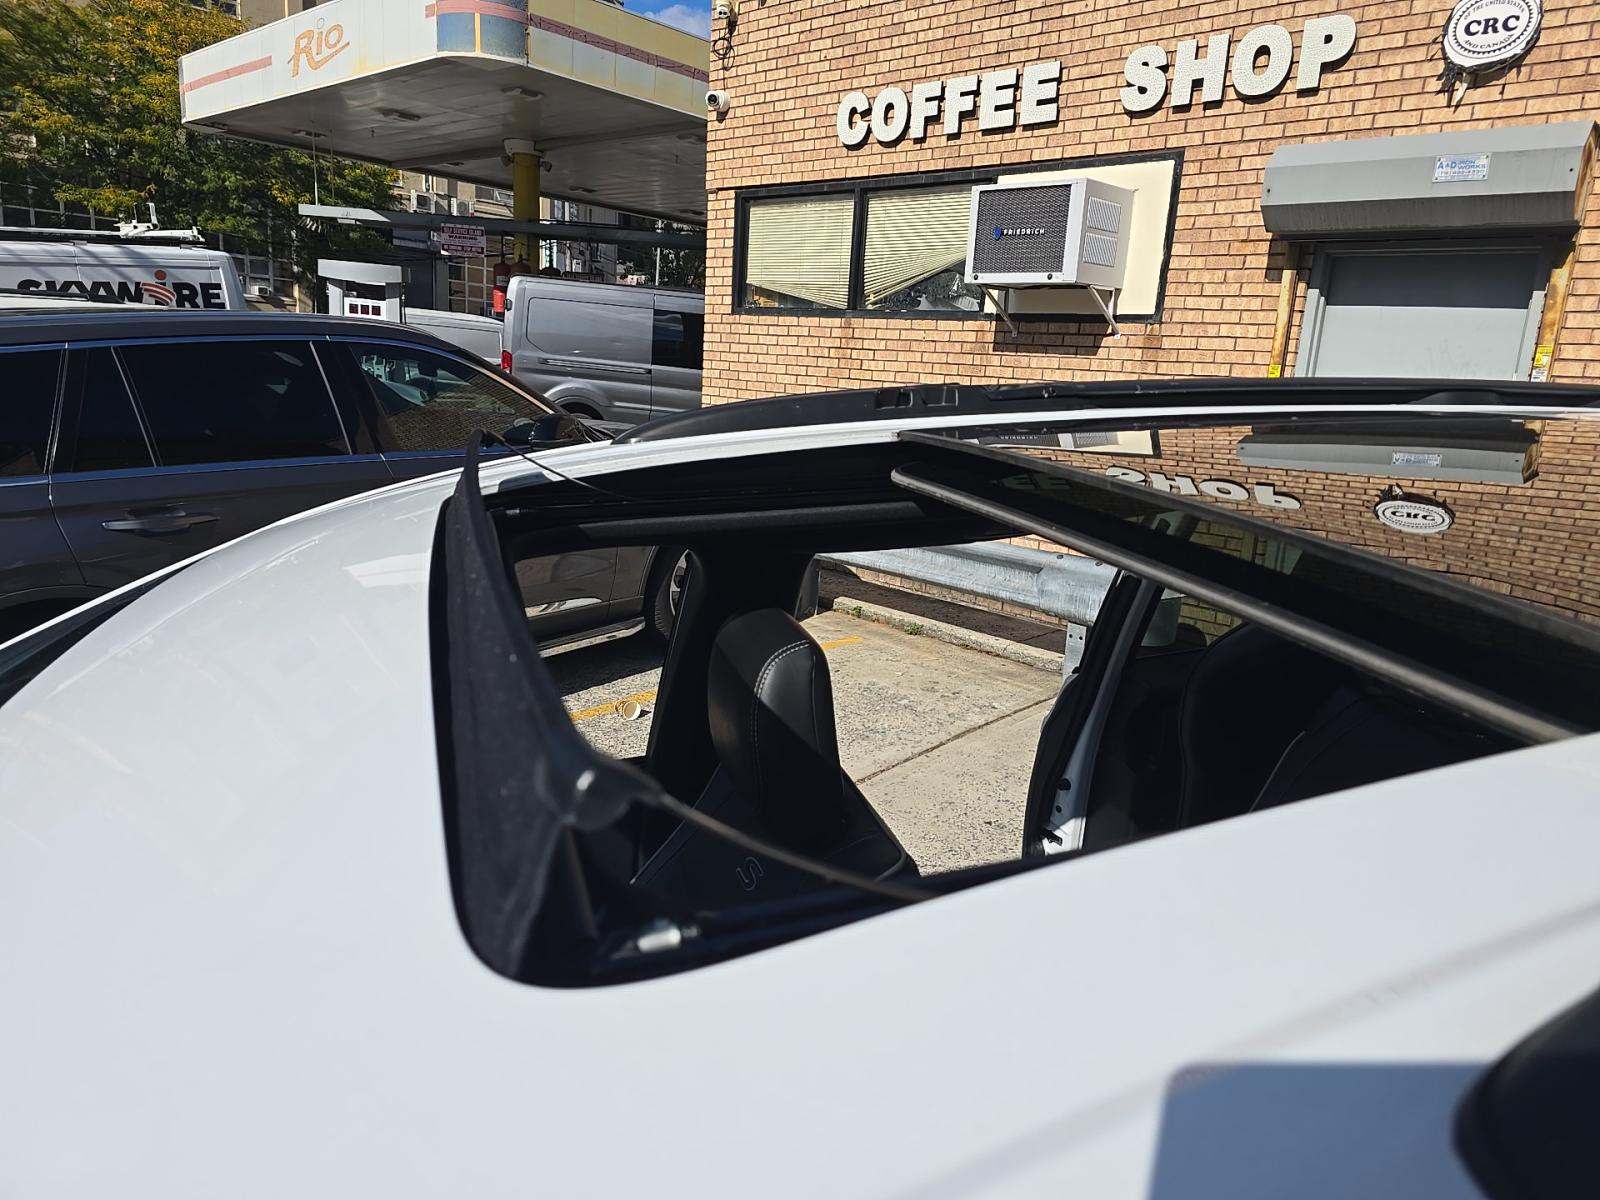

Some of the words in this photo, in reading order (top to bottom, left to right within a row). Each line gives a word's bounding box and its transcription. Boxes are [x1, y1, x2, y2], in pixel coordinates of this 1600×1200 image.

[1464, 15, 1520, 36] CRC
[287, 17, 350, 78] Rio
[1464, 39, 1478, 49] AND
[1480, 33, 1515, 50] CANADA
[836, 61, 1061, 148] COFFEE
[1119, 14, 1357, 115] SHOP
[1003, 227, 1045, 236] FRIEDRICH
